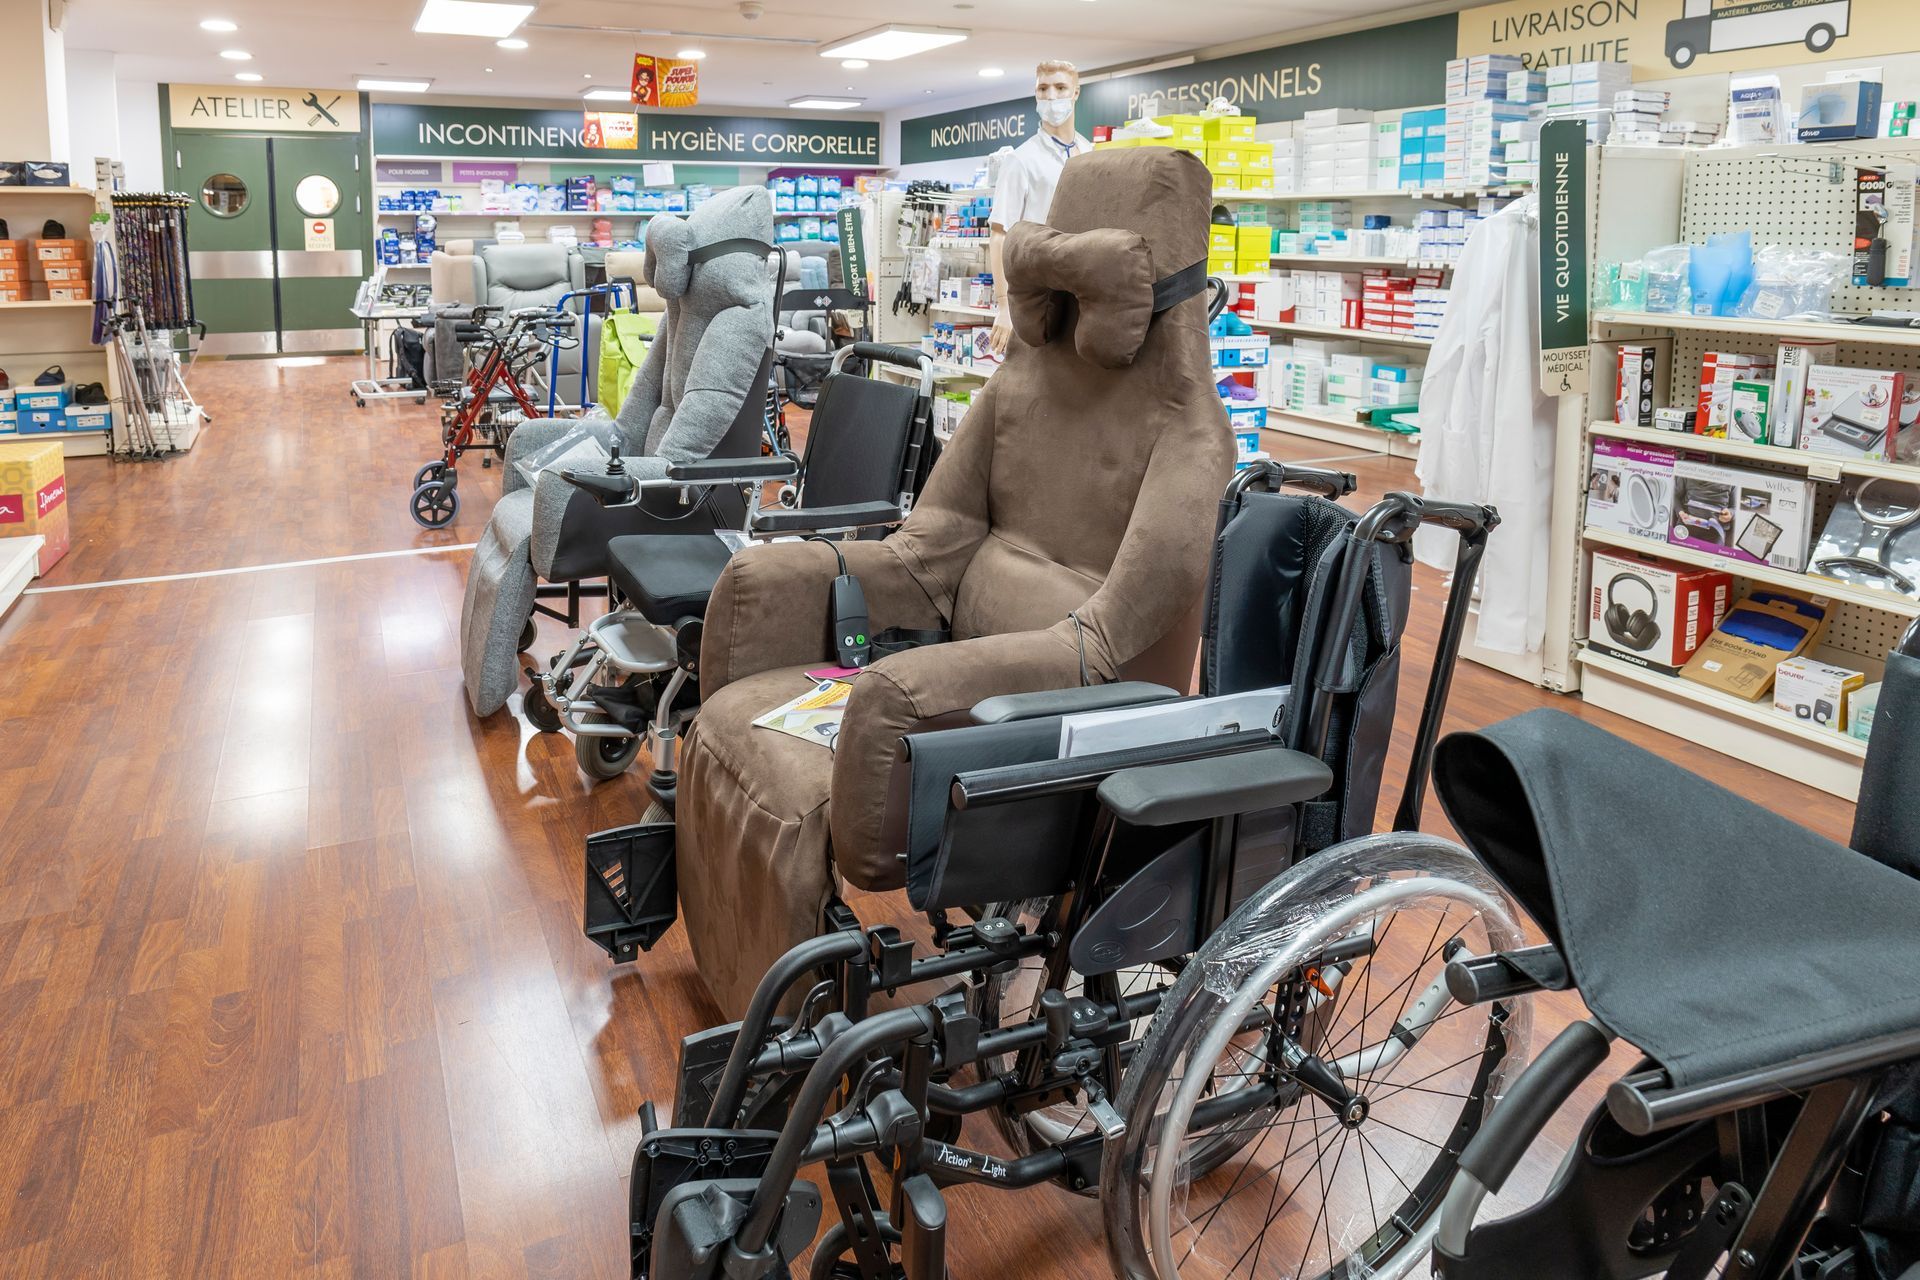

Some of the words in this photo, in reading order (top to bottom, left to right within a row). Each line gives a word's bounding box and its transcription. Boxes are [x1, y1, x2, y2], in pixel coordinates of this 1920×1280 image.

[1491, 0, 1638, 43] LIVRAISON
[1507, 38, 1630, 72] RATUITE
[190, 96, 292, 120] ATELIER
[651, 126, 745, 152] HYGIÈNE
[751, 132, 876, 155] CORPORELLE
[931, 113, 1026, 148] INCONTINENCE
[404, 168, 429, 176] HOMMES
[1859, 181, 1885, 190] GOOD
[844, 212, 856, 254] BIEN-ÊTRE
[1555, 151, 1570, 289] QUOTIDIENNE
[849, 263, 862, 297] ONFORT
[1556, 292, 1570, 323] VIE
[1542, 350, 1587, 362] MOUYSSET
[1783, 346, 1793, 365] TIRE
[1711, 637, 1723, 645] THE
[1723, 641, 1743, 652] BOOK
[1743, 648, 1767, 659] STAND
[1778, 667, 1805, 681] beurer
[981, 1155, 1007, 1178] Light
